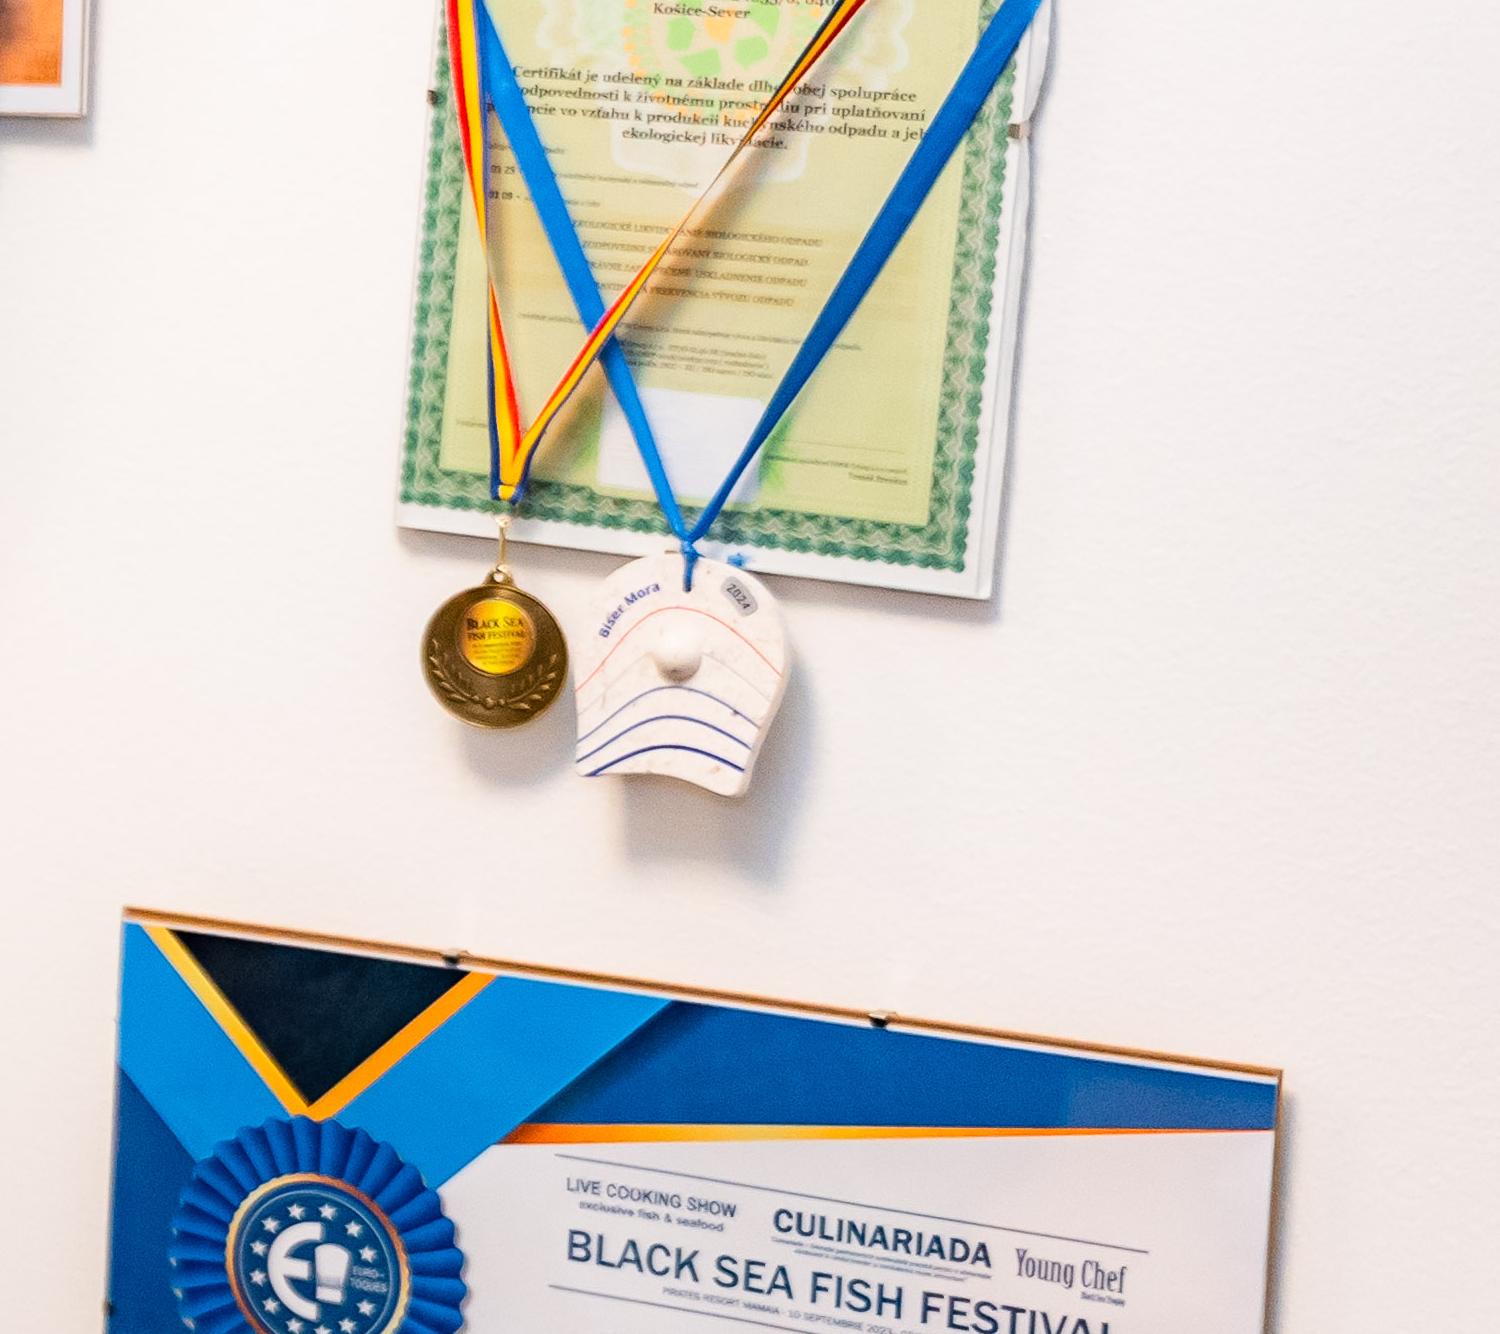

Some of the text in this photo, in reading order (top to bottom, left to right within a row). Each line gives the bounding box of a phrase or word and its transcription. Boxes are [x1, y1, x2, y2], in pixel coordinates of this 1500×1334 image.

[652, 1, 752, 20] Košice-Sever
[513, 64, 918, 103] Certifikát je udelený na základe spolupráce
[560, 105, 577, 117] vo
[634, 108, 642, 121] k
[646, 109, 720, 128] produkcii
[828, 123, 888, 140] odpadu
[623, 87, 927, 123] k životnému pri uplatňovaní
[621, 127, 707, 146] ekologickej
[502, 616, 524, 628] SEA
[599, 582, 661, 639] Biser Mora
[566, 1176, 737, 1218] LIVE COOKING SHOW
[772, 1207, 993, 1269] CULINARIADA
[567, 1228, 701, 1283] BLACK
[712, 1253, 795, 1300] SEA
[809, 1270, 904, 1320] FISH
[1015, 1246, 1075, 1290] Young
[1080, 1259, 1129, 1295] Chef
